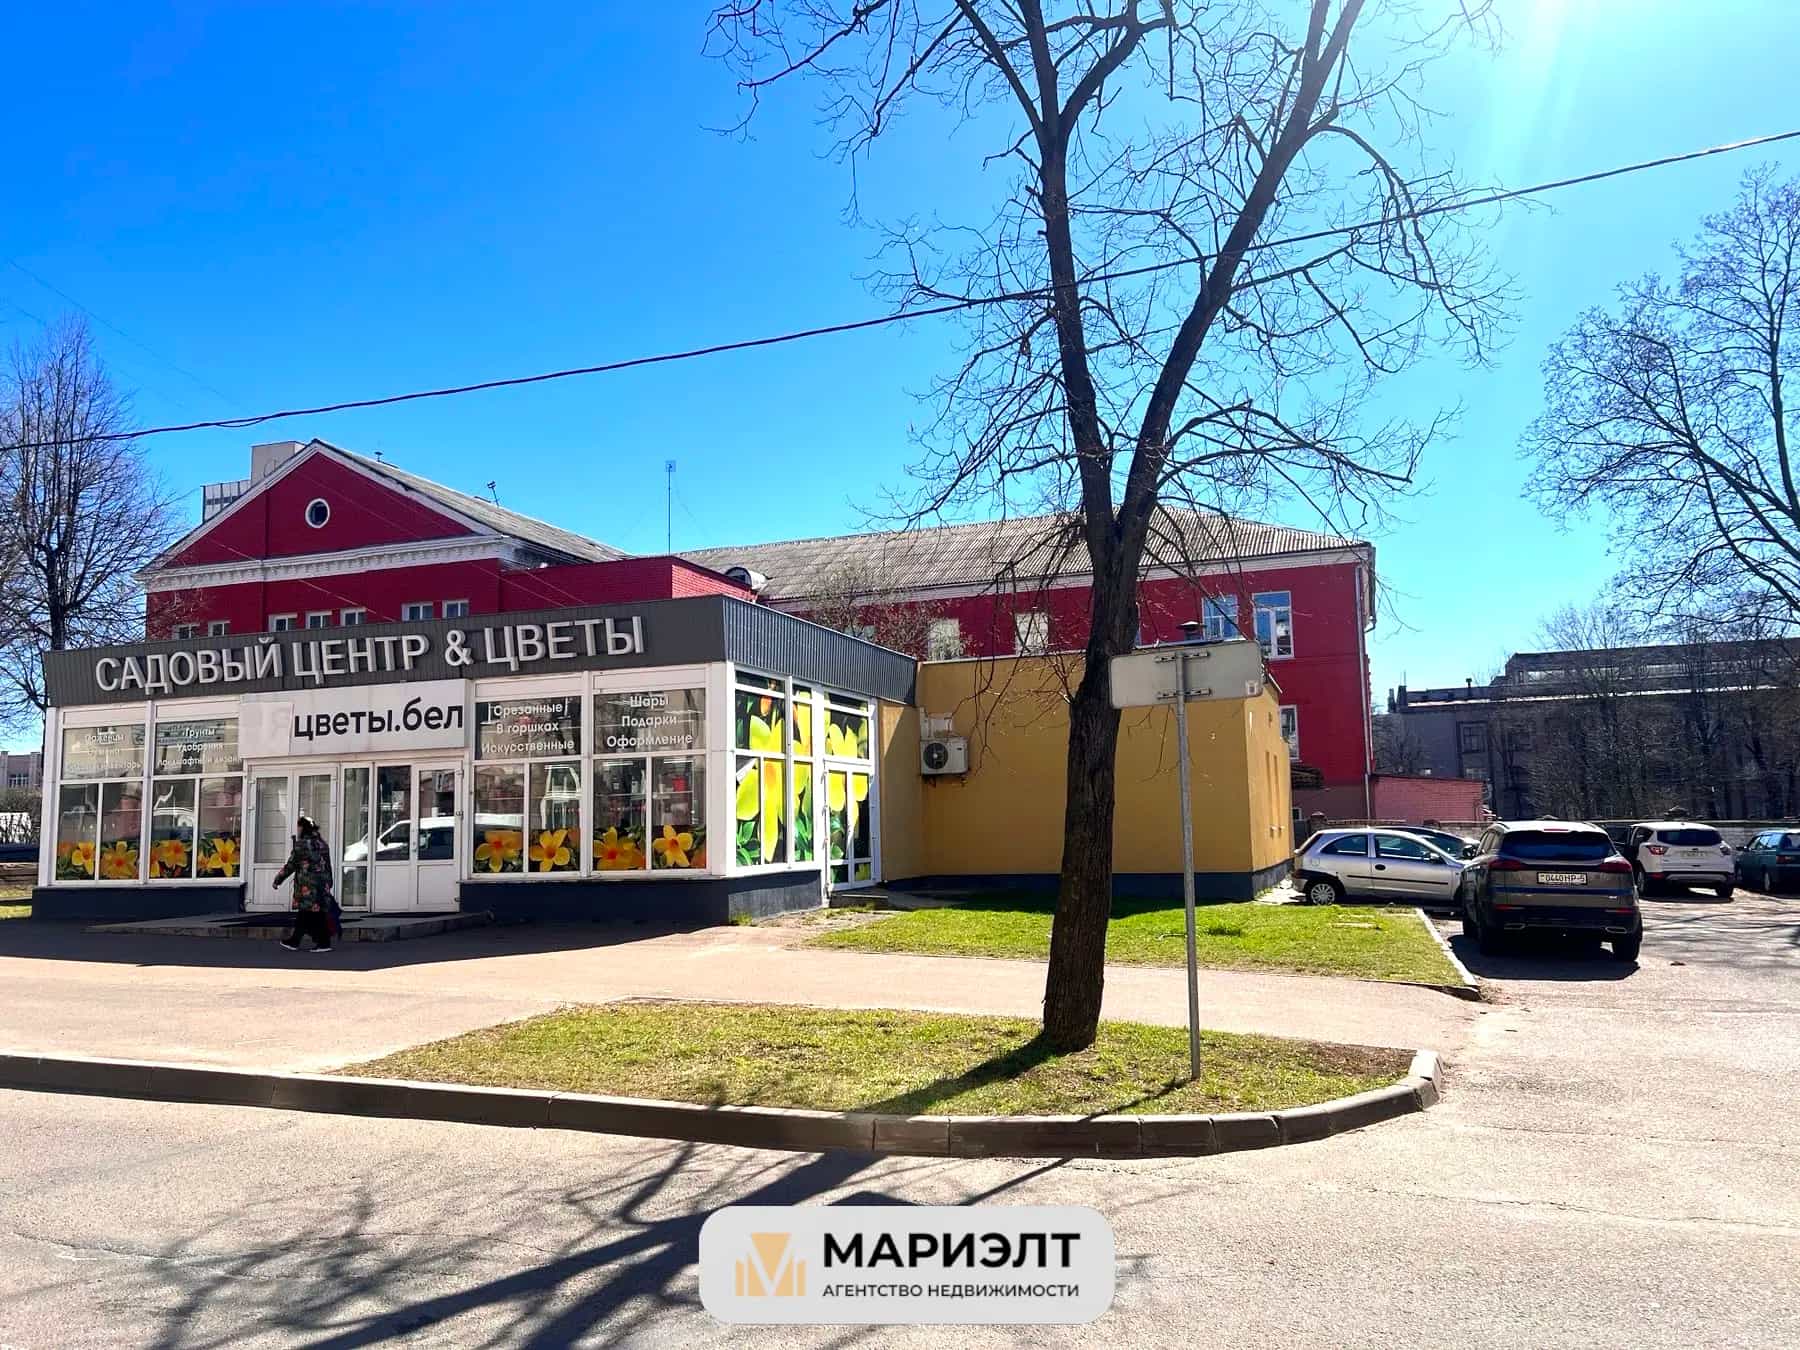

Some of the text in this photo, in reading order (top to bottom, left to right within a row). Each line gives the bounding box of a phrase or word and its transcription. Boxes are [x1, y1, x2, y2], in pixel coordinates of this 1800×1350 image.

[95, 615, 645, 695] САДОВЫЙ ЦЕНТР & ЦВЕТЫ
[630, 695, 669, 710] Шары
[493, 703, 564, 718] Срезанные
[293, 696, 463, 741] цветы.бел
[621, 715, 677, 729] Подарки
[507, 721, 559, 736] горшках
[481, 739, 575, 755] Искусственные
[606, 734, 694, 749] Оформление
